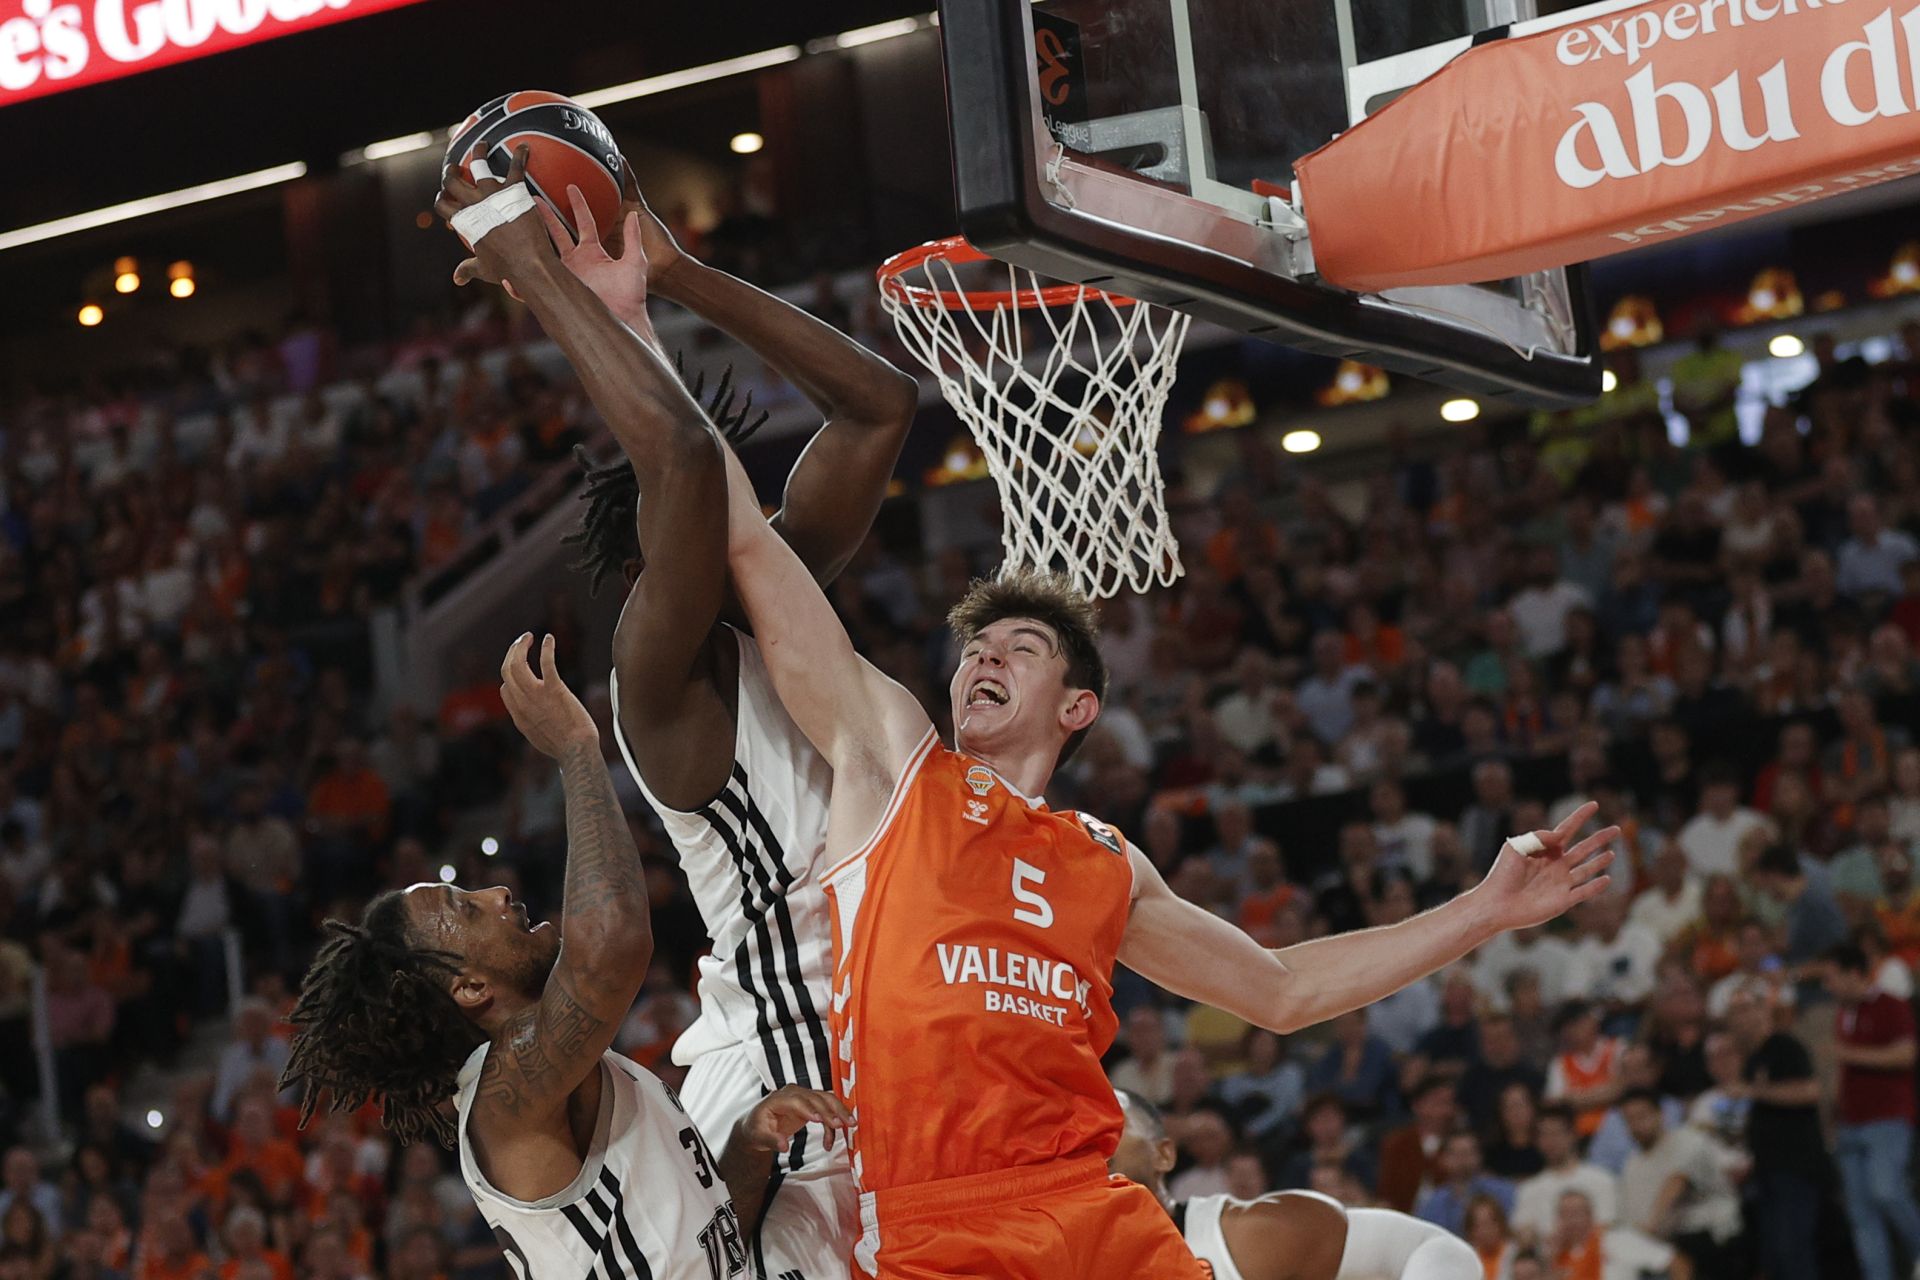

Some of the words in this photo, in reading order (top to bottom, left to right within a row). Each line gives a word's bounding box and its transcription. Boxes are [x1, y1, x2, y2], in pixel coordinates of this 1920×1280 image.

[1555, 58, 1801, 188] abu
[1011, 856, 1054, 929] 5
[985, 990, 1067, 1027] BASKET
